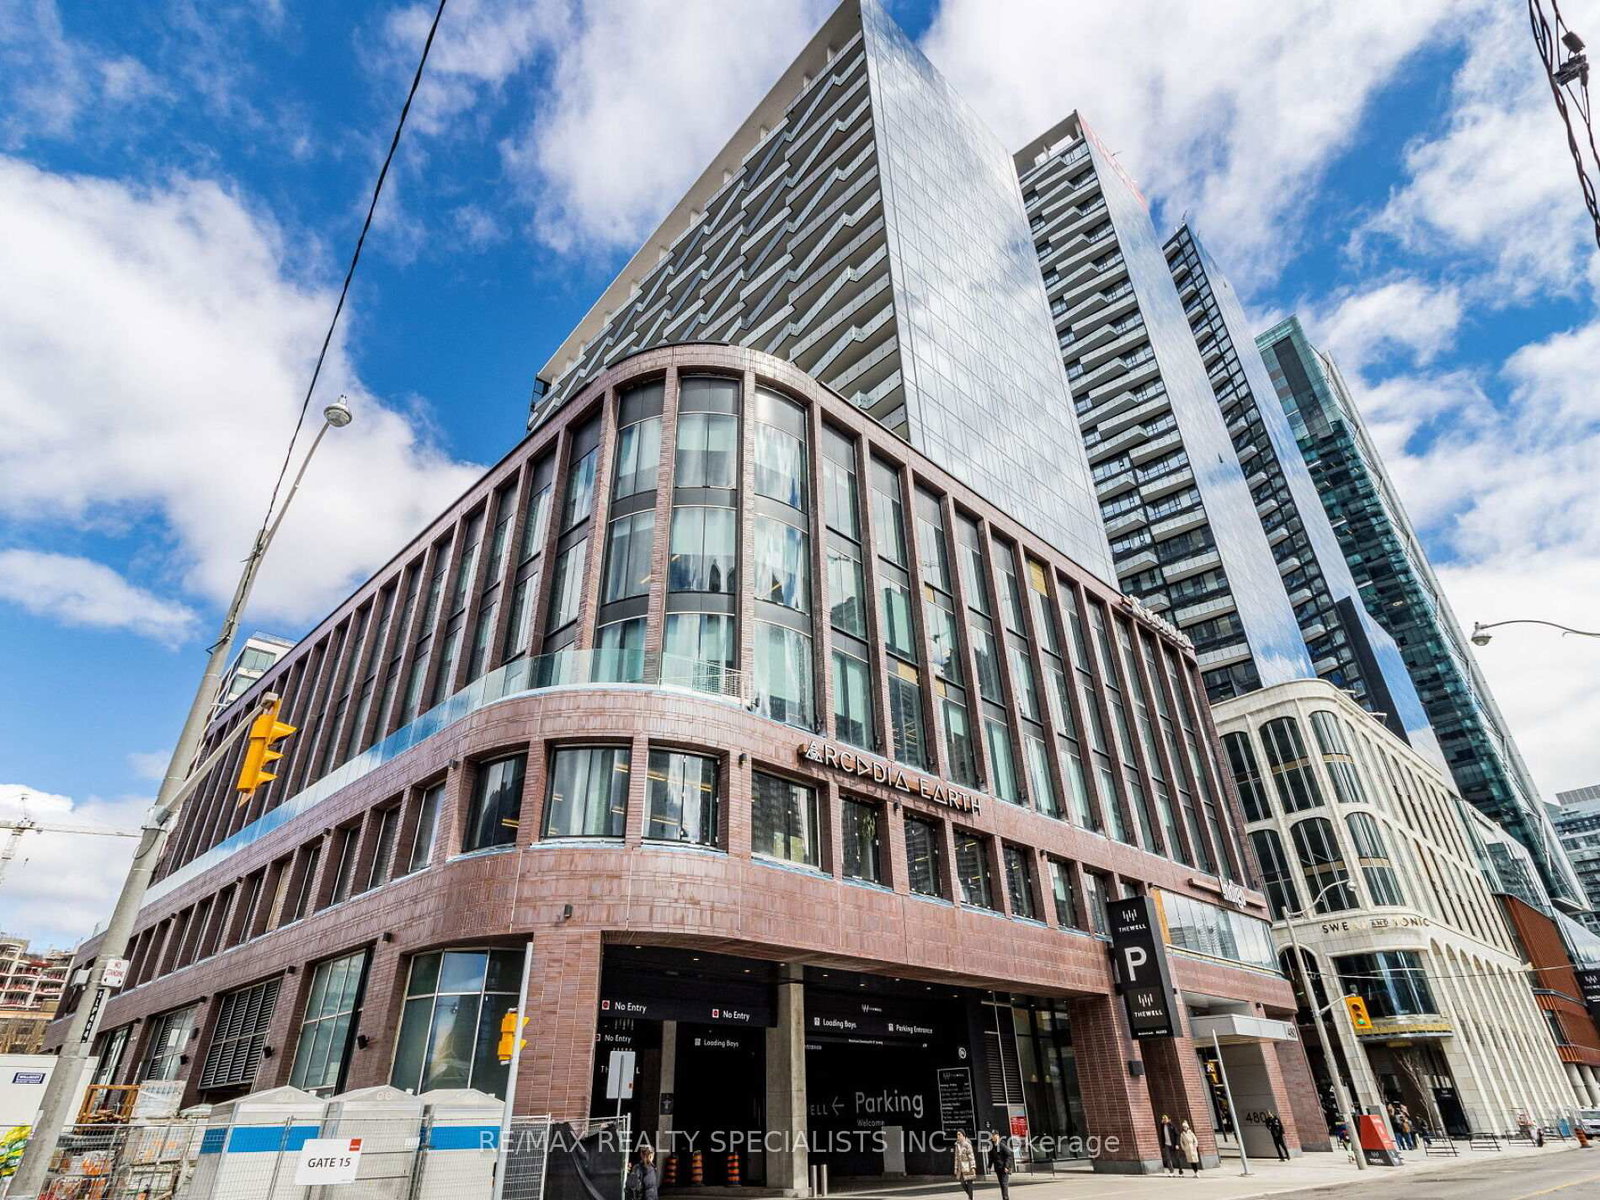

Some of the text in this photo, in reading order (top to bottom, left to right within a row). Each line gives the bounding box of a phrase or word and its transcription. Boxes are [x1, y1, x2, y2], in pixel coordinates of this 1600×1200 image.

[805, 741, 981, 815] ARCADIA EARTH
[1124, 946, 1147, 981] P
[615, 1002, 647, 1014] No Entry
[723, 1010, 750, 1021] No Entry
[823, 1019, 857, 1029] Loading Bays
[896, 1025, 933, 1034] Parking Entrance
[615, 1035, 632, 1044] Entry
[704, 1039, 739, 1048] Loading Bays
[855, 1089, 923, 1118] Parking
[857, 1119, 885, 1127] Welcome
[308, 1157, 351, 1168] GATE 15
